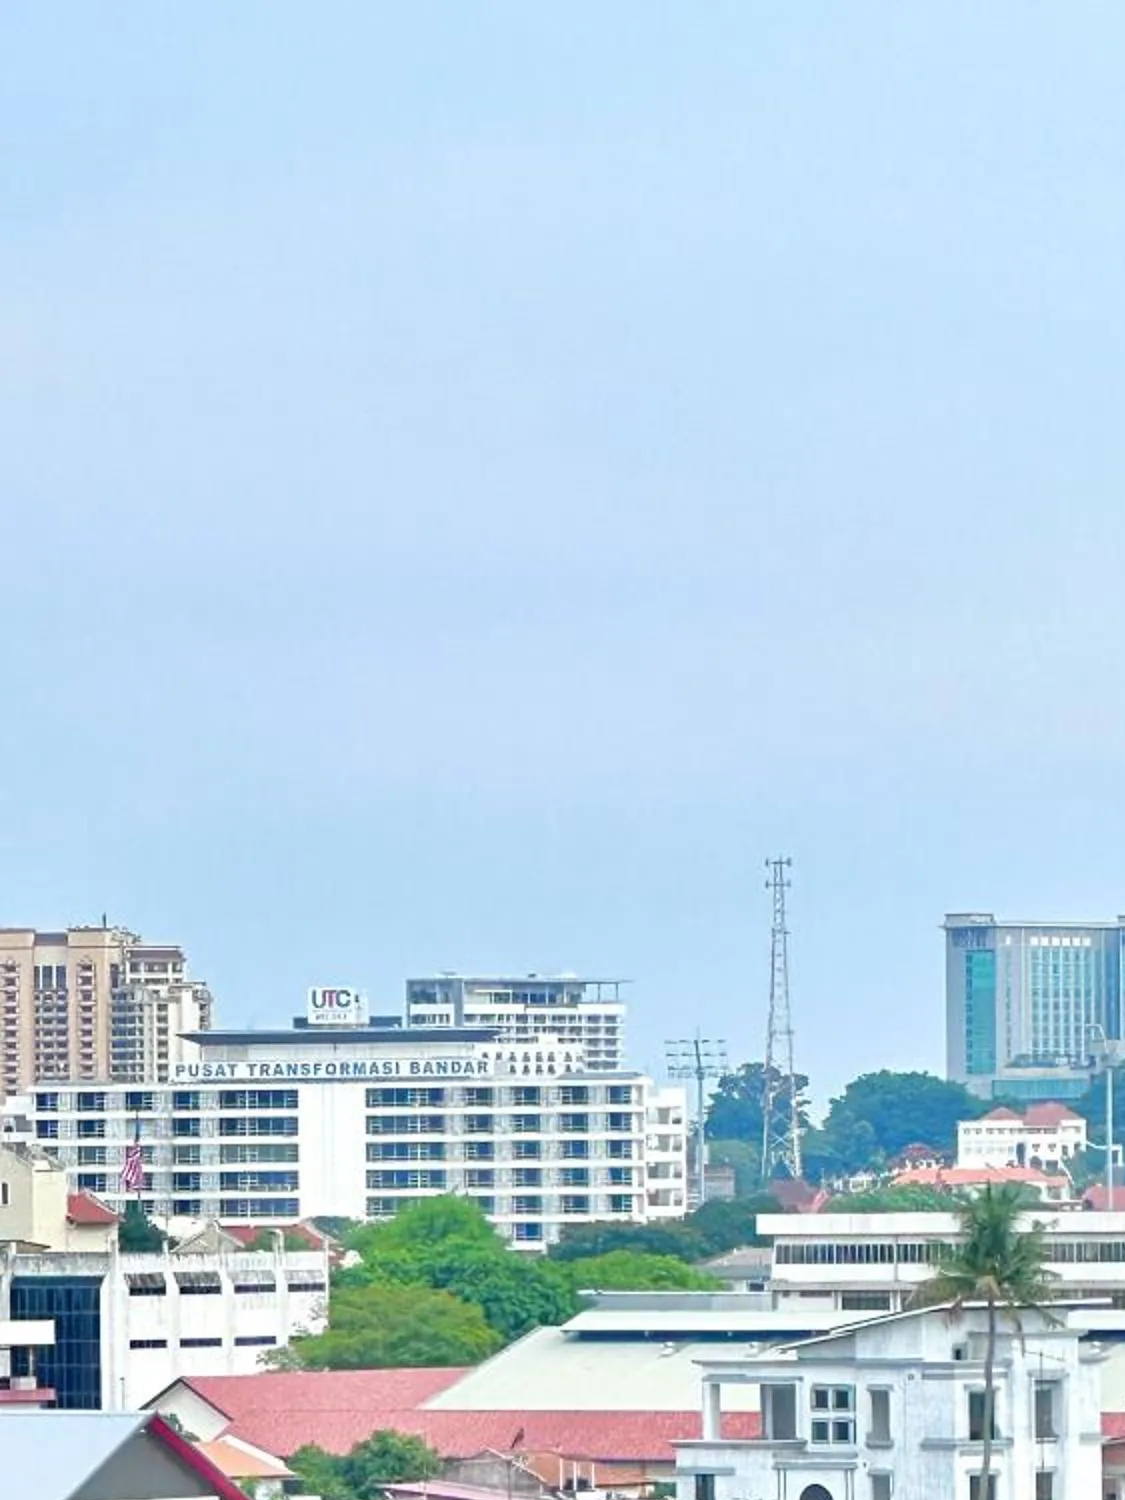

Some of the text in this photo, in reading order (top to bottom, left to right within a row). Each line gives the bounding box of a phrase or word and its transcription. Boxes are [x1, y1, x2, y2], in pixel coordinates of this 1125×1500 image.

[311, 989, 351, 1008] UTC
[175, 1061, 488, 1077] PUSAT TRANSFORMASI BANDAR
